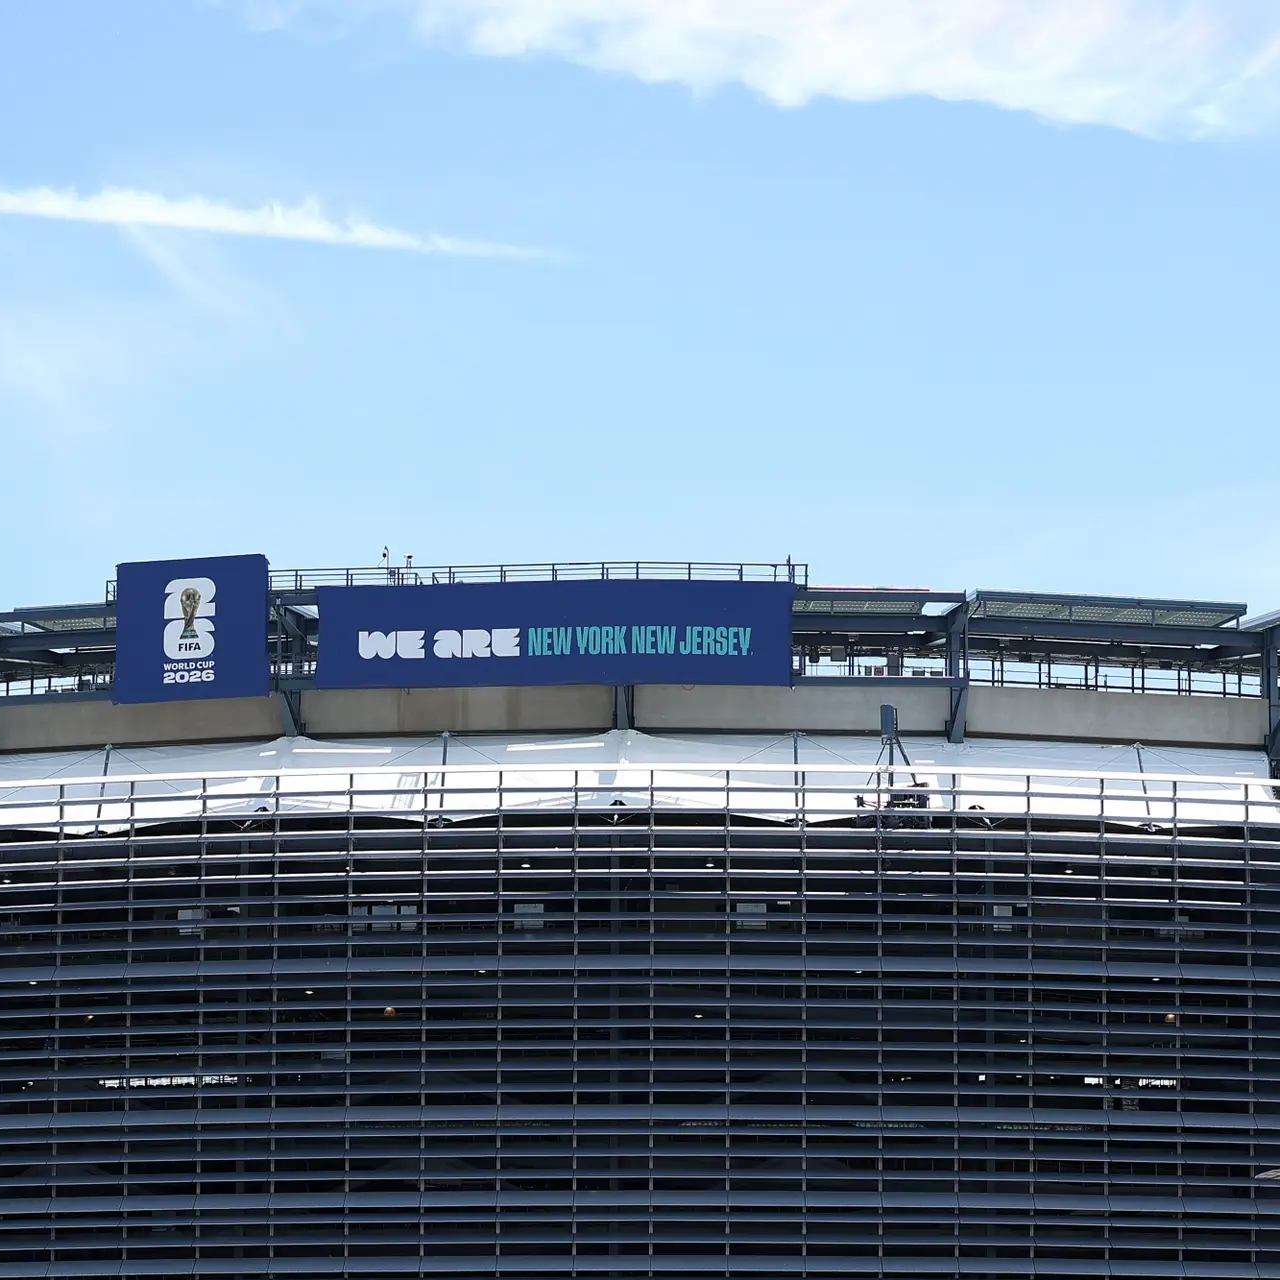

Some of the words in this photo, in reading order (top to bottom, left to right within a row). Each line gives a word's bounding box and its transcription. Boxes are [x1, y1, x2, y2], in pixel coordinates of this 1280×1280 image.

[178, 642, 201, 652] FIFA
[358, 630, 425, 660] WE
[433, 628, 520, 659] ARE
[528, 627, 572, 656] NEW
[576, 626, 627, 655] YORK
[632, 626, 676, 654] NEW
[680, 626, 752, 656] JERSEY
[164, 662, 196, 670] WORLD
[197, 660, 215, 669] CUP
[163, 670, 215, 684] 2026
